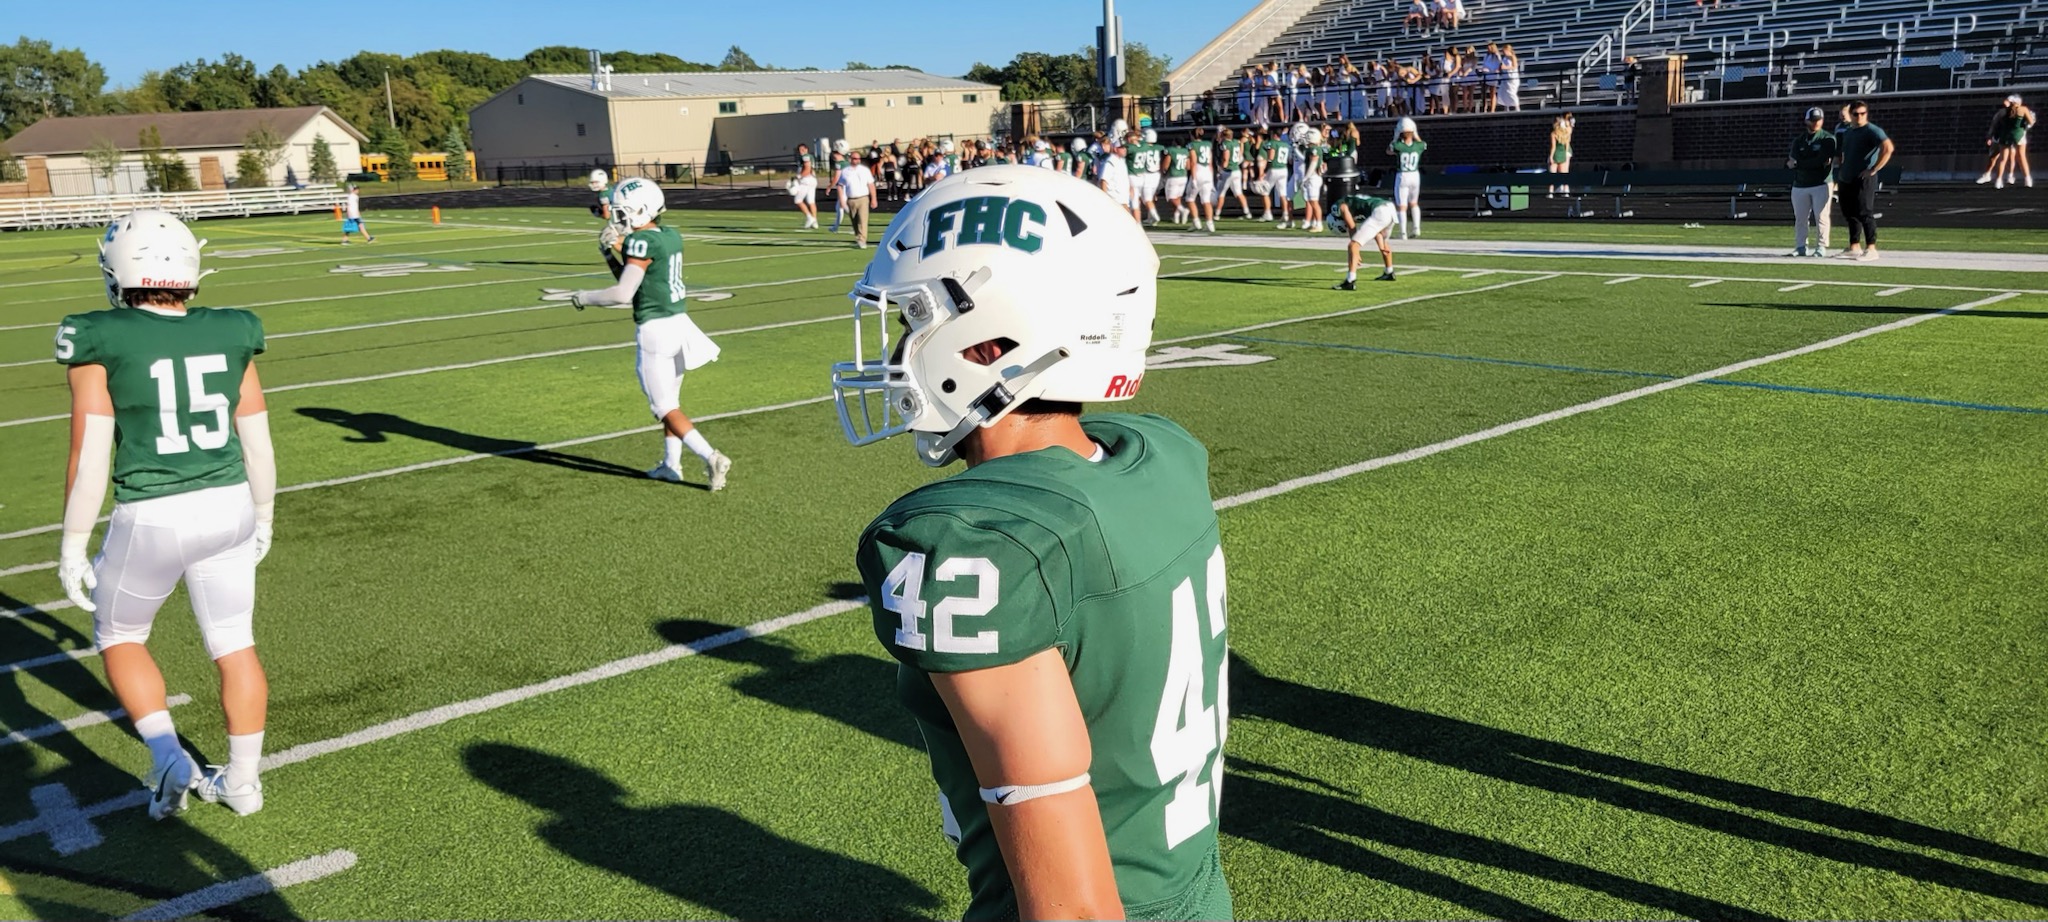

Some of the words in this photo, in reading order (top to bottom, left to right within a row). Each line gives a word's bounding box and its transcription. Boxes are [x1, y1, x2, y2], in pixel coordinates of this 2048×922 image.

[626, 237, 648, 258] 10
[919, 195, 1047, 261] FHC
[141, 277, 190, 289] Riddell
[668, 251, 686, 303] 10
[150, 353, 230, 455] 15
[880, 551, 1000, 655] 42
